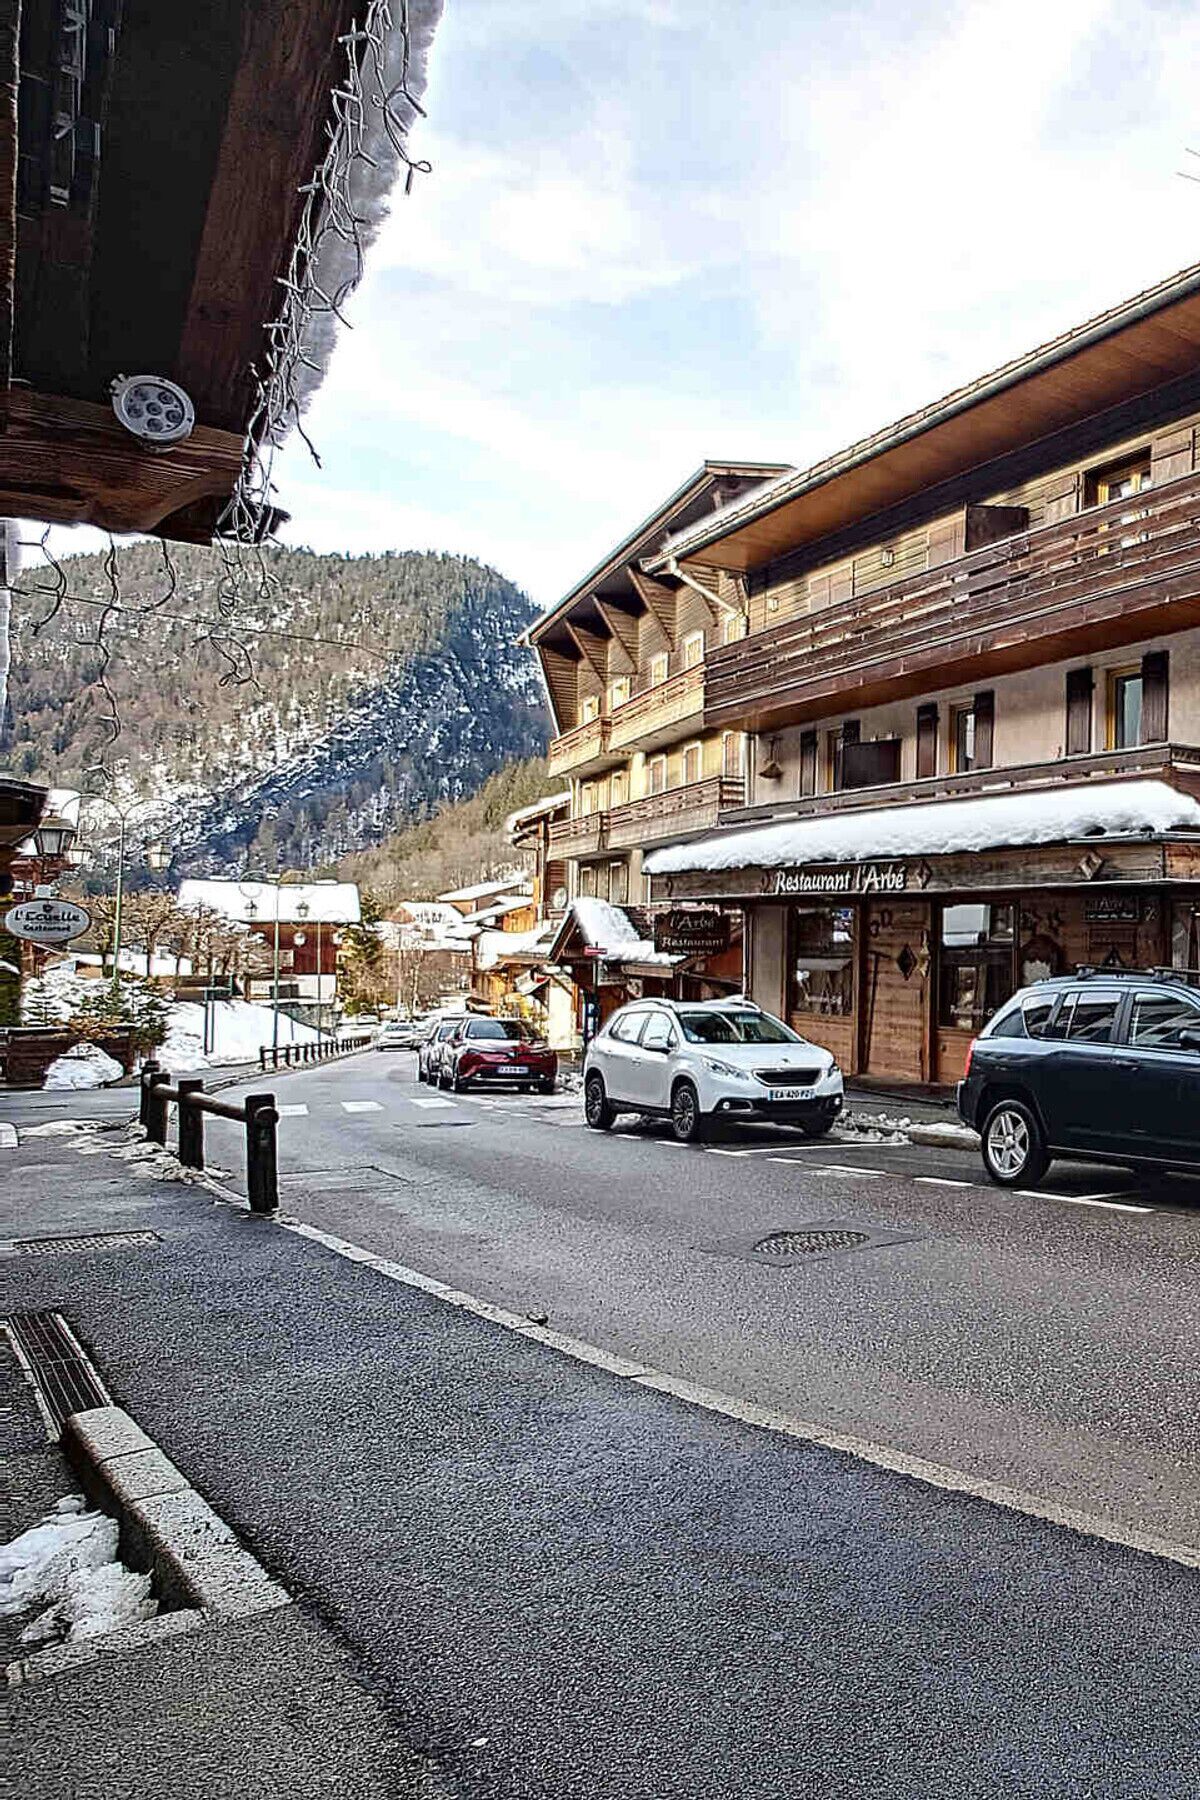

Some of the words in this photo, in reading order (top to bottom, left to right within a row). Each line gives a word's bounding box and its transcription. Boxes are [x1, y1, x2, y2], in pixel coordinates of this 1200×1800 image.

[774, 869, 850, 894] Restaurant
[855, 864, 906, 893] l'Arbé
[661, 936, 723, 948] Restaurant
